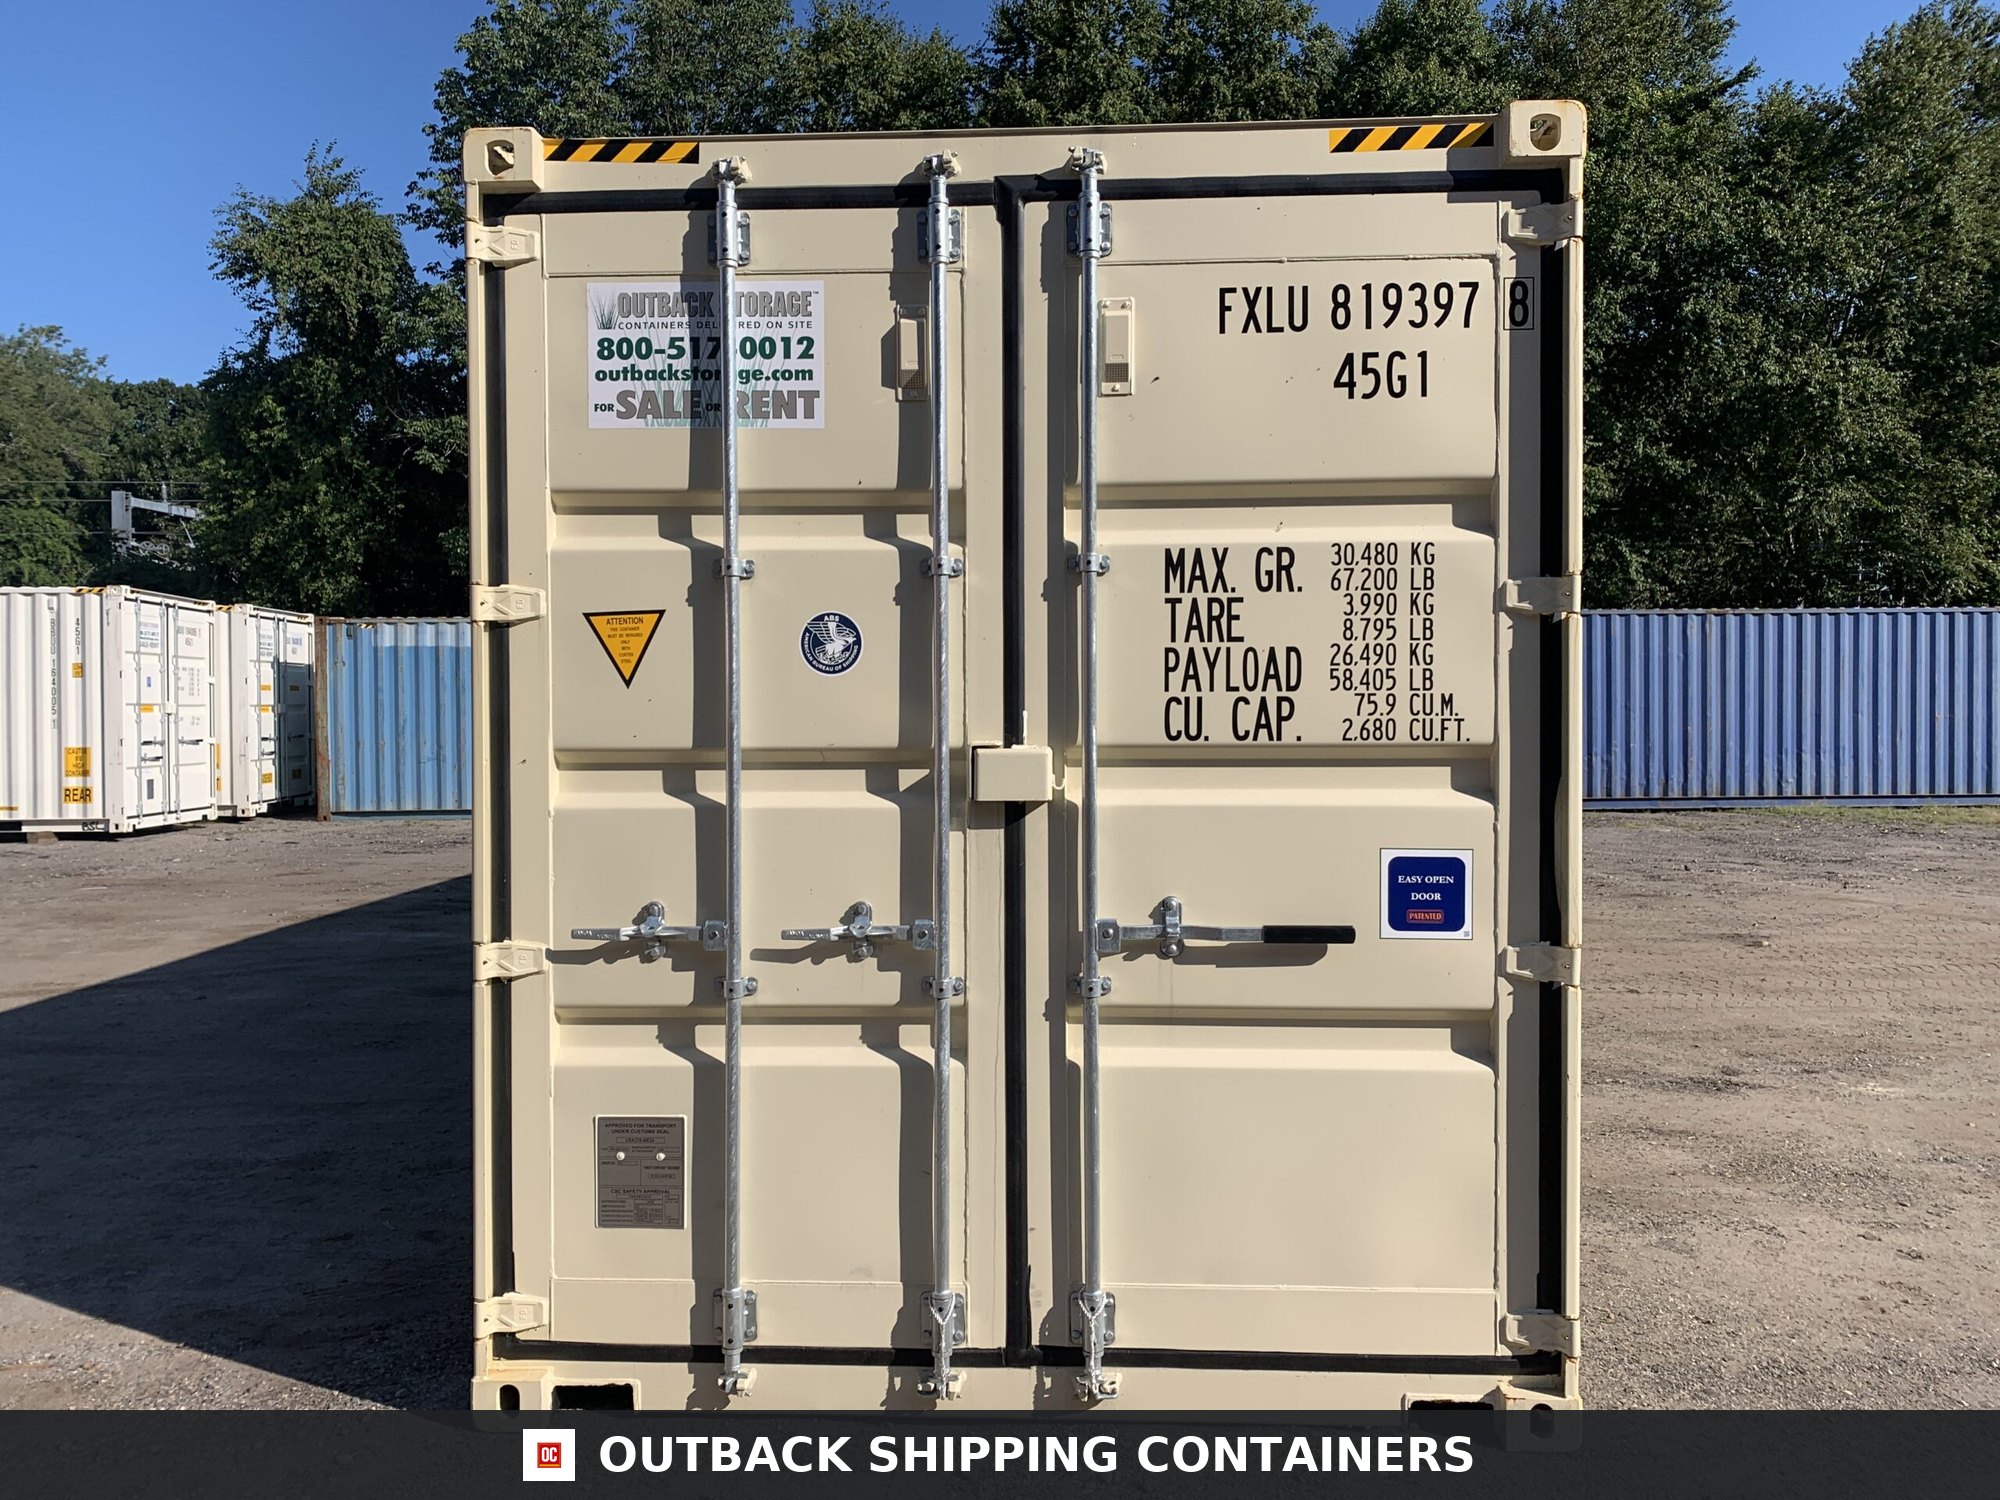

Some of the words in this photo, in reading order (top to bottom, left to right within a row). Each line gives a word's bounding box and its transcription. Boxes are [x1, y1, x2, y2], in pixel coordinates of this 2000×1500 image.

[618, 291, 714, 318] OUTBACK
[1219, 285, 1308, 334] FXLU
[1330, 282, 1480, 330] 819397
[1509, 280, 1529, 327] 8
[618, 321, 691, 330] CONTAINERS
[766, 321, 782, 329] ON
[788, 321, 813, 329] SITE
[597, 336, 815, 360] 800-5170012
[595, 364, 814, 384] outbackstorge.com
[1333, 350, 1427, 400] 45G1
[594, 404, 614, 412] FOR
[616, 389, 702, 419] SALE
[736, 390, 820, 419] RENT
[1165, 547, 1236, 593] MAX.
[1255, 546, 1303, 592] GR.
[1331, 542, 1398, 566] 30,480
[1411, 542, 1435, 565] KG
[1331, 567, 1397, 591] 67,200
[1411, 567, 1434, 590] LB
[606, 617, 643, 625] ATTENTION
[1165, 597, 1245, 643] TARE
[1343, 593, 1397, 616] 3,990
[1410, 593, 1434, 616] KG
[1342, 618, 1396, 641] 8,795
[1410, 618, 1434, 641] LB
[1164, 646, 1302, 692] PAYLOAD
[1330, 643, 1396, 667] 26,490
[1410, 643, 1434, 666] KG
[1330, 668, 1396, 692] 58,405
[1410, 668, 1434, 691] LB
[1164, 695, 1209, 742] CU.
[1232, 695, 1302, 741] CAP.
[1354, 693, 1396, 716] 75.9
[1409, 693, 1459, 716] CU.M.
[1342, 718, 1396, 742] 2,680
[1409, 718, 1470, 741] CU.FT.
[64, 789, 91, 801] REAR
